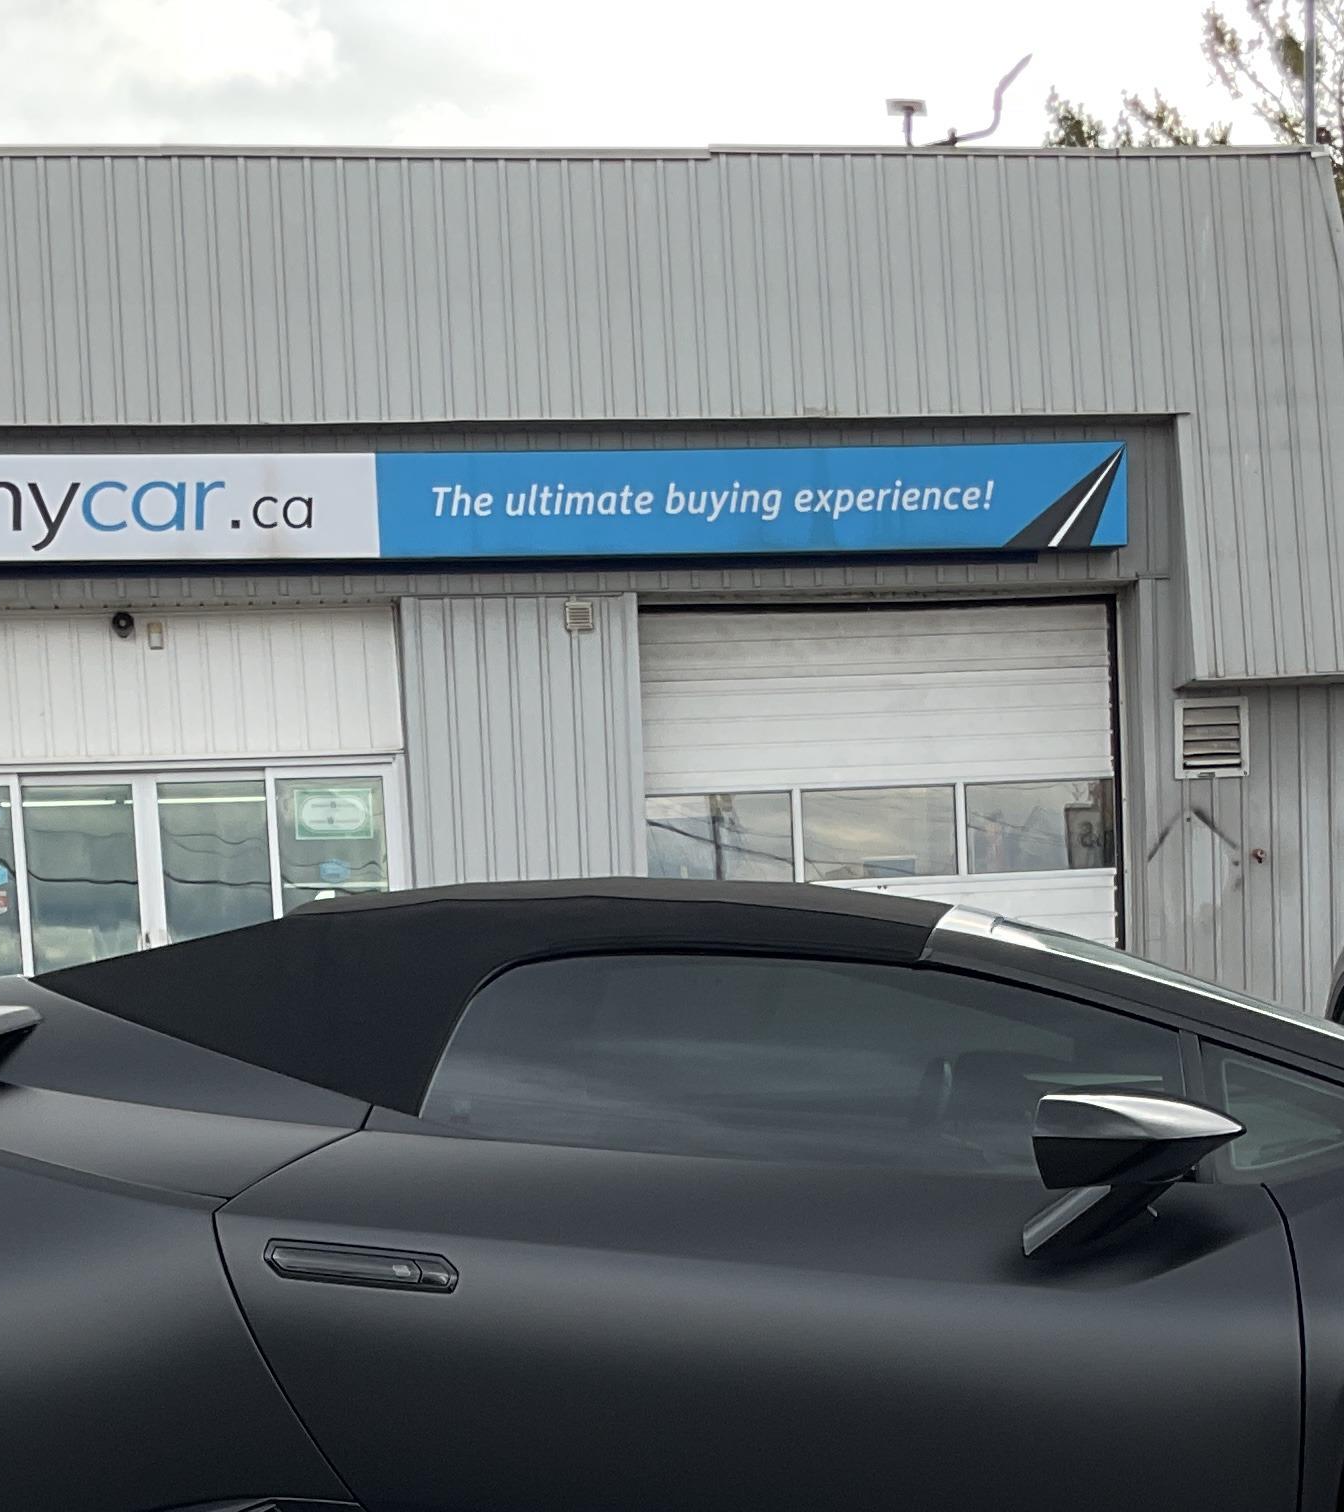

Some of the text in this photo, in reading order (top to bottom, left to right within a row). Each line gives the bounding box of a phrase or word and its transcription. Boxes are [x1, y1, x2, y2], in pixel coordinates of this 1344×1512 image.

[431, 479, 994, 522] The ultimate buying experience!
